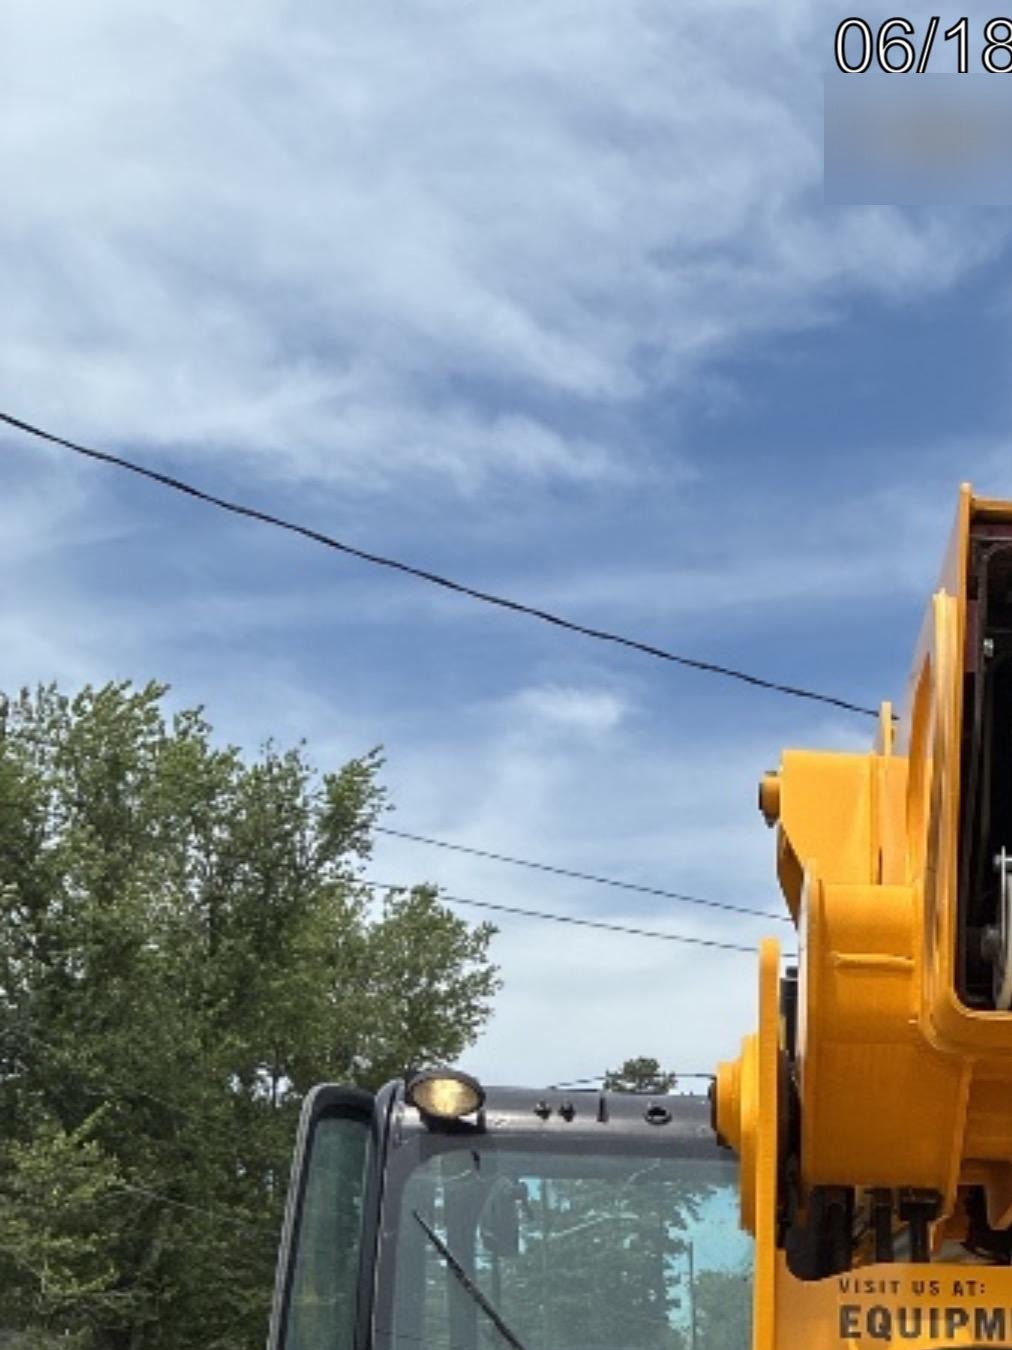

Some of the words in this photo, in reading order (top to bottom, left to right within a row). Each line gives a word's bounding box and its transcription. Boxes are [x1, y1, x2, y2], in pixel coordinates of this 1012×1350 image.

[838, 1278, 899, 1295] VISIT
[911, 1280, 941, 1296] US
[953, 1280, 986, 1297] AT:
